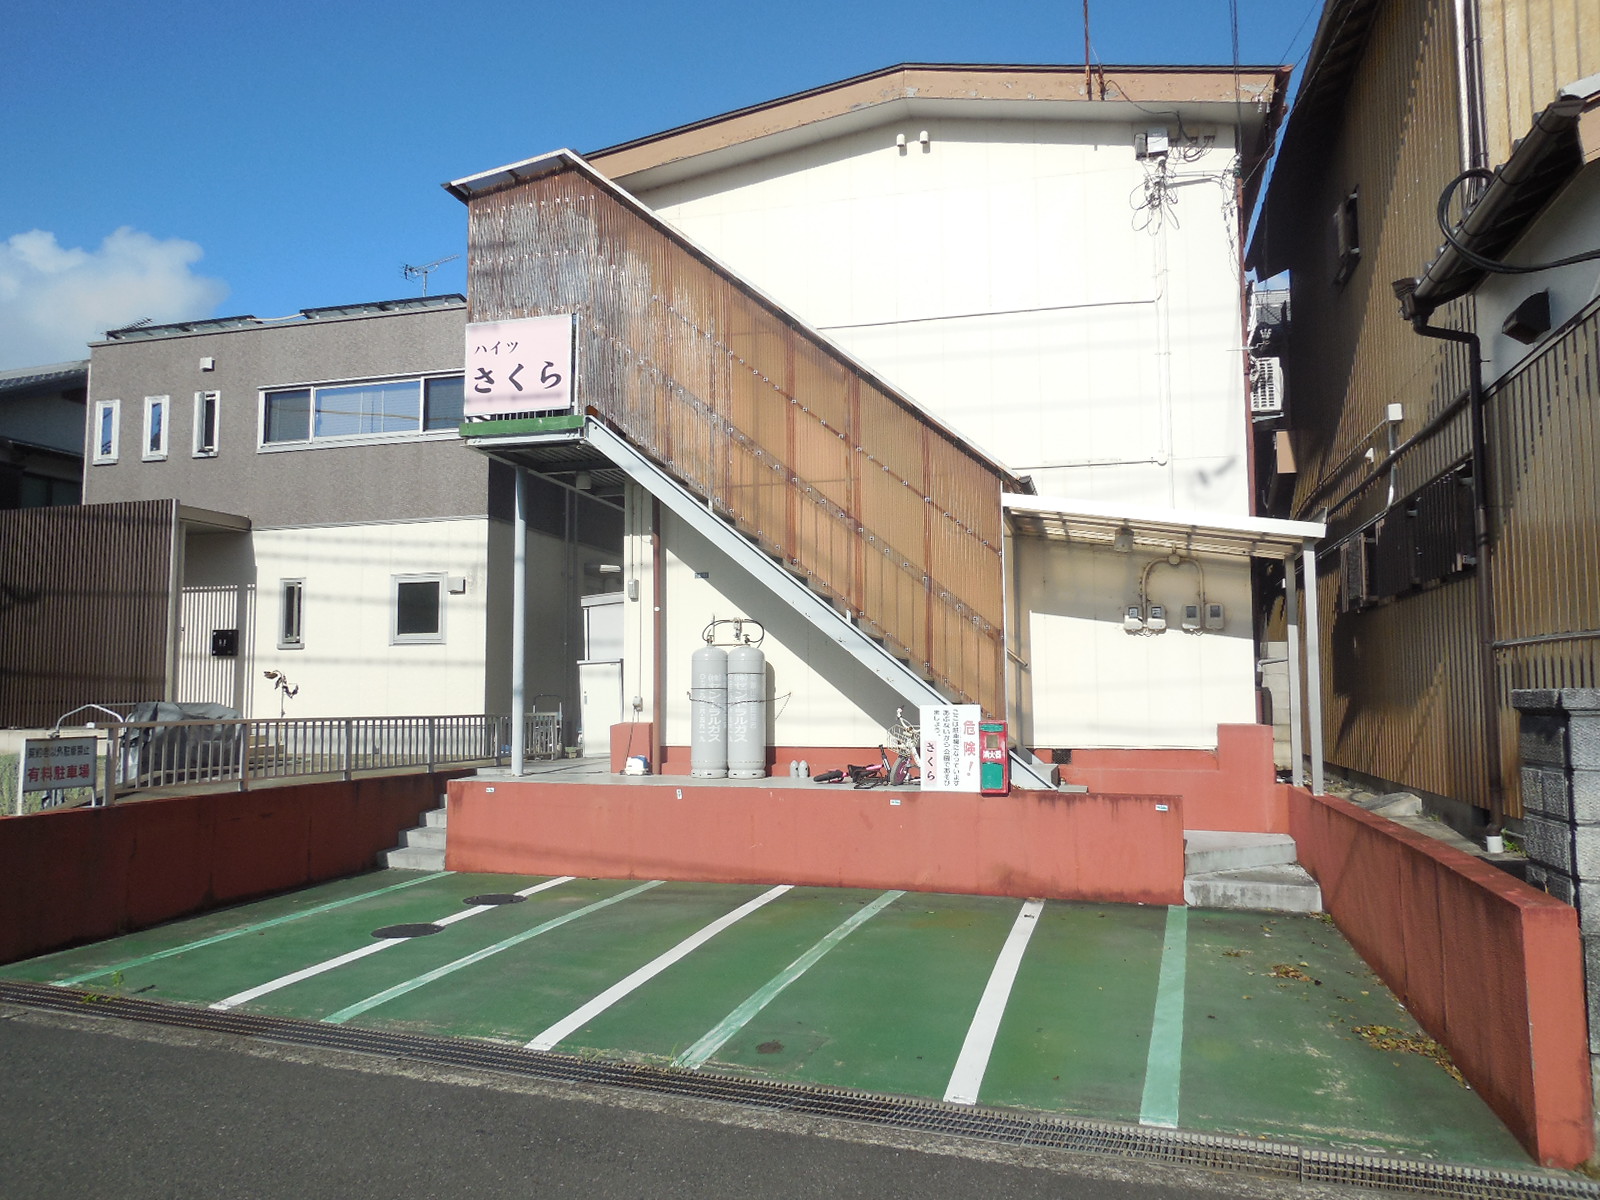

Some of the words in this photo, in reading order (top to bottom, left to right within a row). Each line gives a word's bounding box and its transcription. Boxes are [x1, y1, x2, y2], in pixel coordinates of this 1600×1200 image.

[474, 341, 519, 355] ハイツ
[474, 360, 562, 394] さくら
[27, 763, 90, 783] 有料駐車場
[926, 742, 936, 781] さくら
